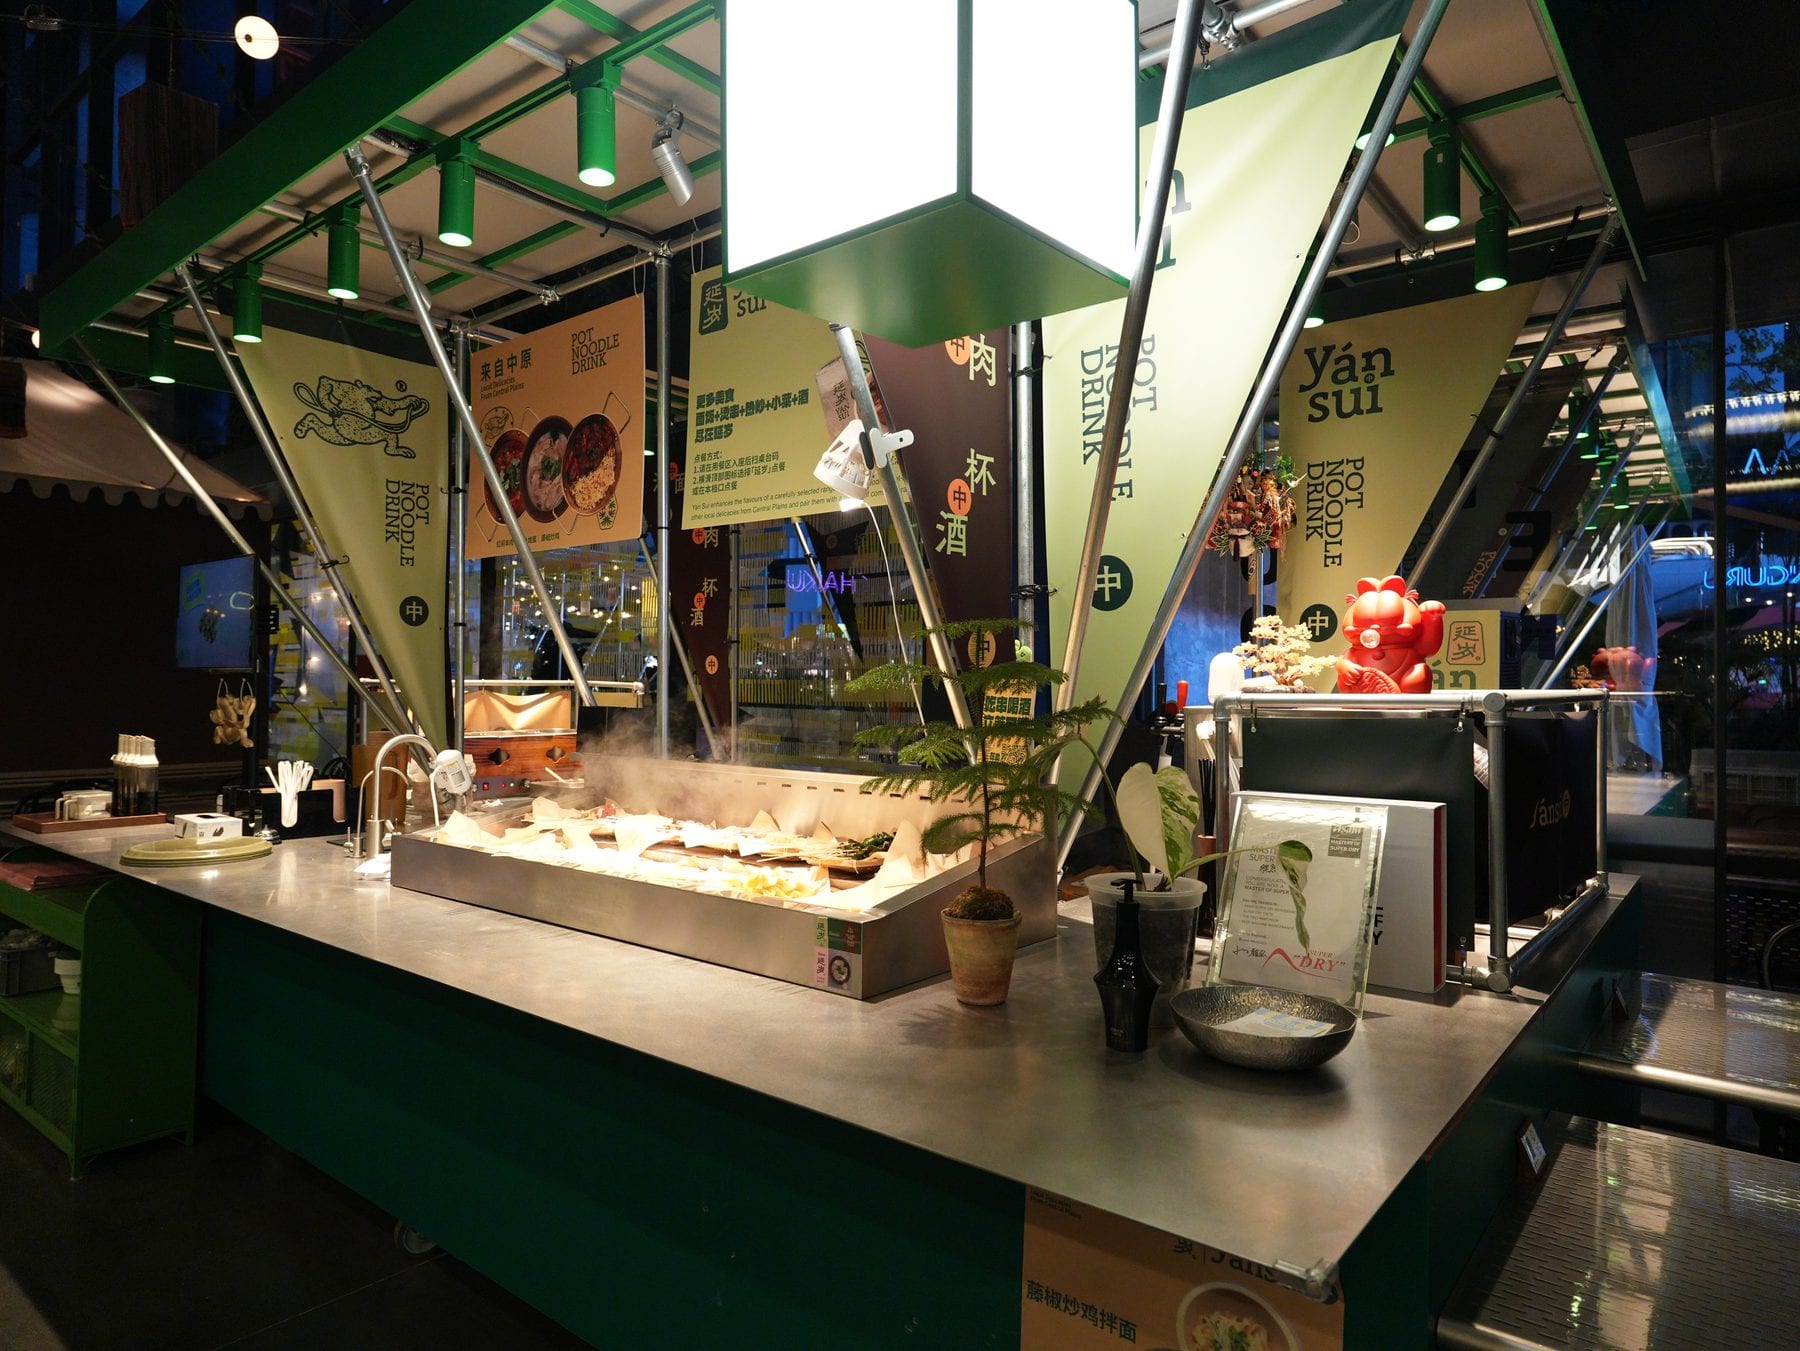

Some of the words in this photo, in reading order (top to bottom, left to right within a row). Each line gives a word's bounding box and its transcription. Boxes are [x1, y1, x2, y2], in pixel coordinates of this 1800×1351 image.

[571, 328, 594, 346] POT
[571, 334, 619, 361] NOODLE
[481, 348, 532, 382] 来自中原
[571, 352, 607, 375] DRINK
[1298, 341, 1395, 393] yán
[696, 388, 735, 409] 更多美食
[1080, 346, 1105, 465] DRINK
[1307, 374, 1383, 423] sui
[694, 423, 734, 444] 尽在延岁
[710, 499, 734, 508] enhances
[743, 495, 762, 504] flavours
[774, 492, 796, 502] carefully
[797, 488, 820, 496] selected
[1345, 457, 1365, 509] POT
[385, 478, 401, 544] DRINK
[416, 484, 430, 525] POT
[704, 512, 716, 520] local
[716, 509, 740, 518] delicacies
[752, 505, 770, 513] Central
[1306, 462, 1325, 542] DRINK
[1323, 458, 1345, 568] NOODLE
[400, 480, 416, 567] NOODLE
[1094, 565, 1121, 602] 中
[406, 601, 423, 622] 中
[1308, 610, 1329, 636] 中
[1248, 854, 1275, 863] SUPER
[1310, 950, 1334, 958] SUPER
[1026, 1279, 1137, 1344] 藤椒炒鸡拌面
